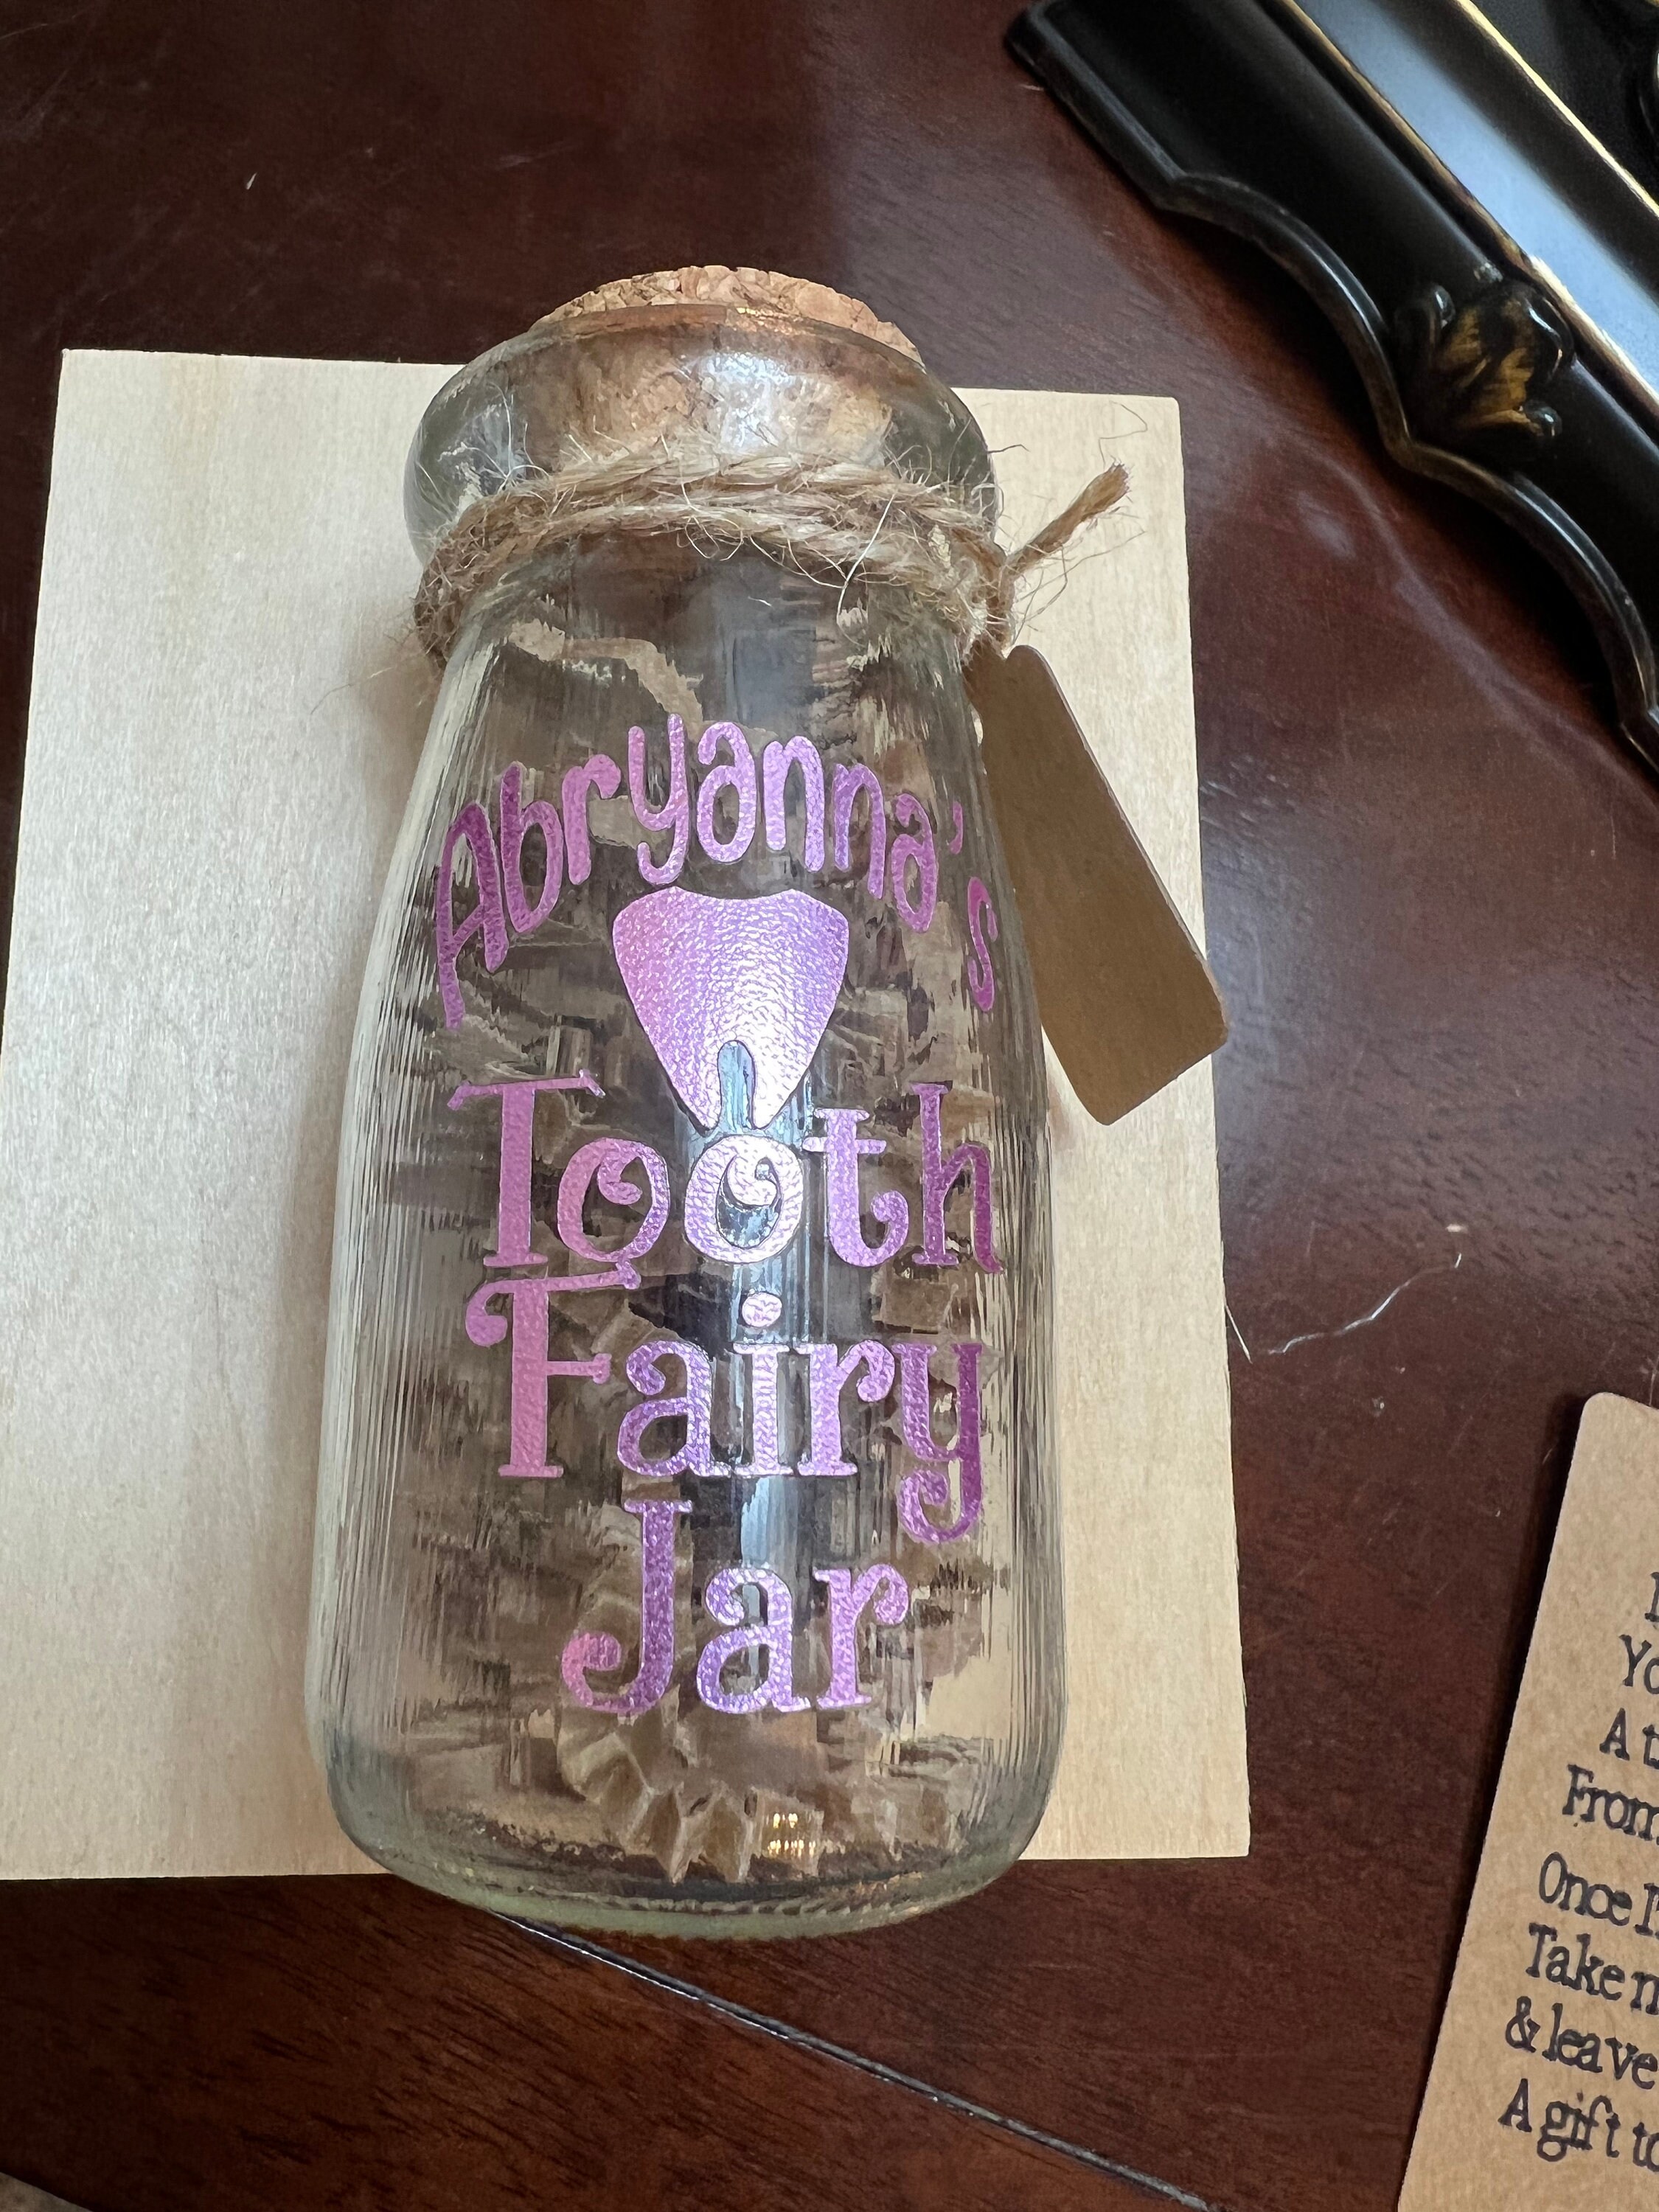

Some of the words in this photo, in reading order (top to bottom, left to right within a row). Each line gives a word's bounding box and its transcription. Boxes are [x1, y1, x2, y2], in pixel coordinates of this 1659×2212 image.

[435, 713, 998, 1029] Abryanna's
[447, 1069, 1004, 1272] Tooth
[465, 1258, 984, 1544] Fairy
[561, 1498, 909, 1714] Jar
[1599, 1708, 1630, 1761] A
[1562, 1763, 1659, 1846] From
[1539, 1851, 1632, 1926] Once
[1526, 1922, 1625, 2000] Take
[1506, 1996, 1540, 2053] &
[1542, 2003, 1658, 2090] leave
[1498, 2079, 1532, 2132] A
[1537, 2091, 1621, 2162] gift
